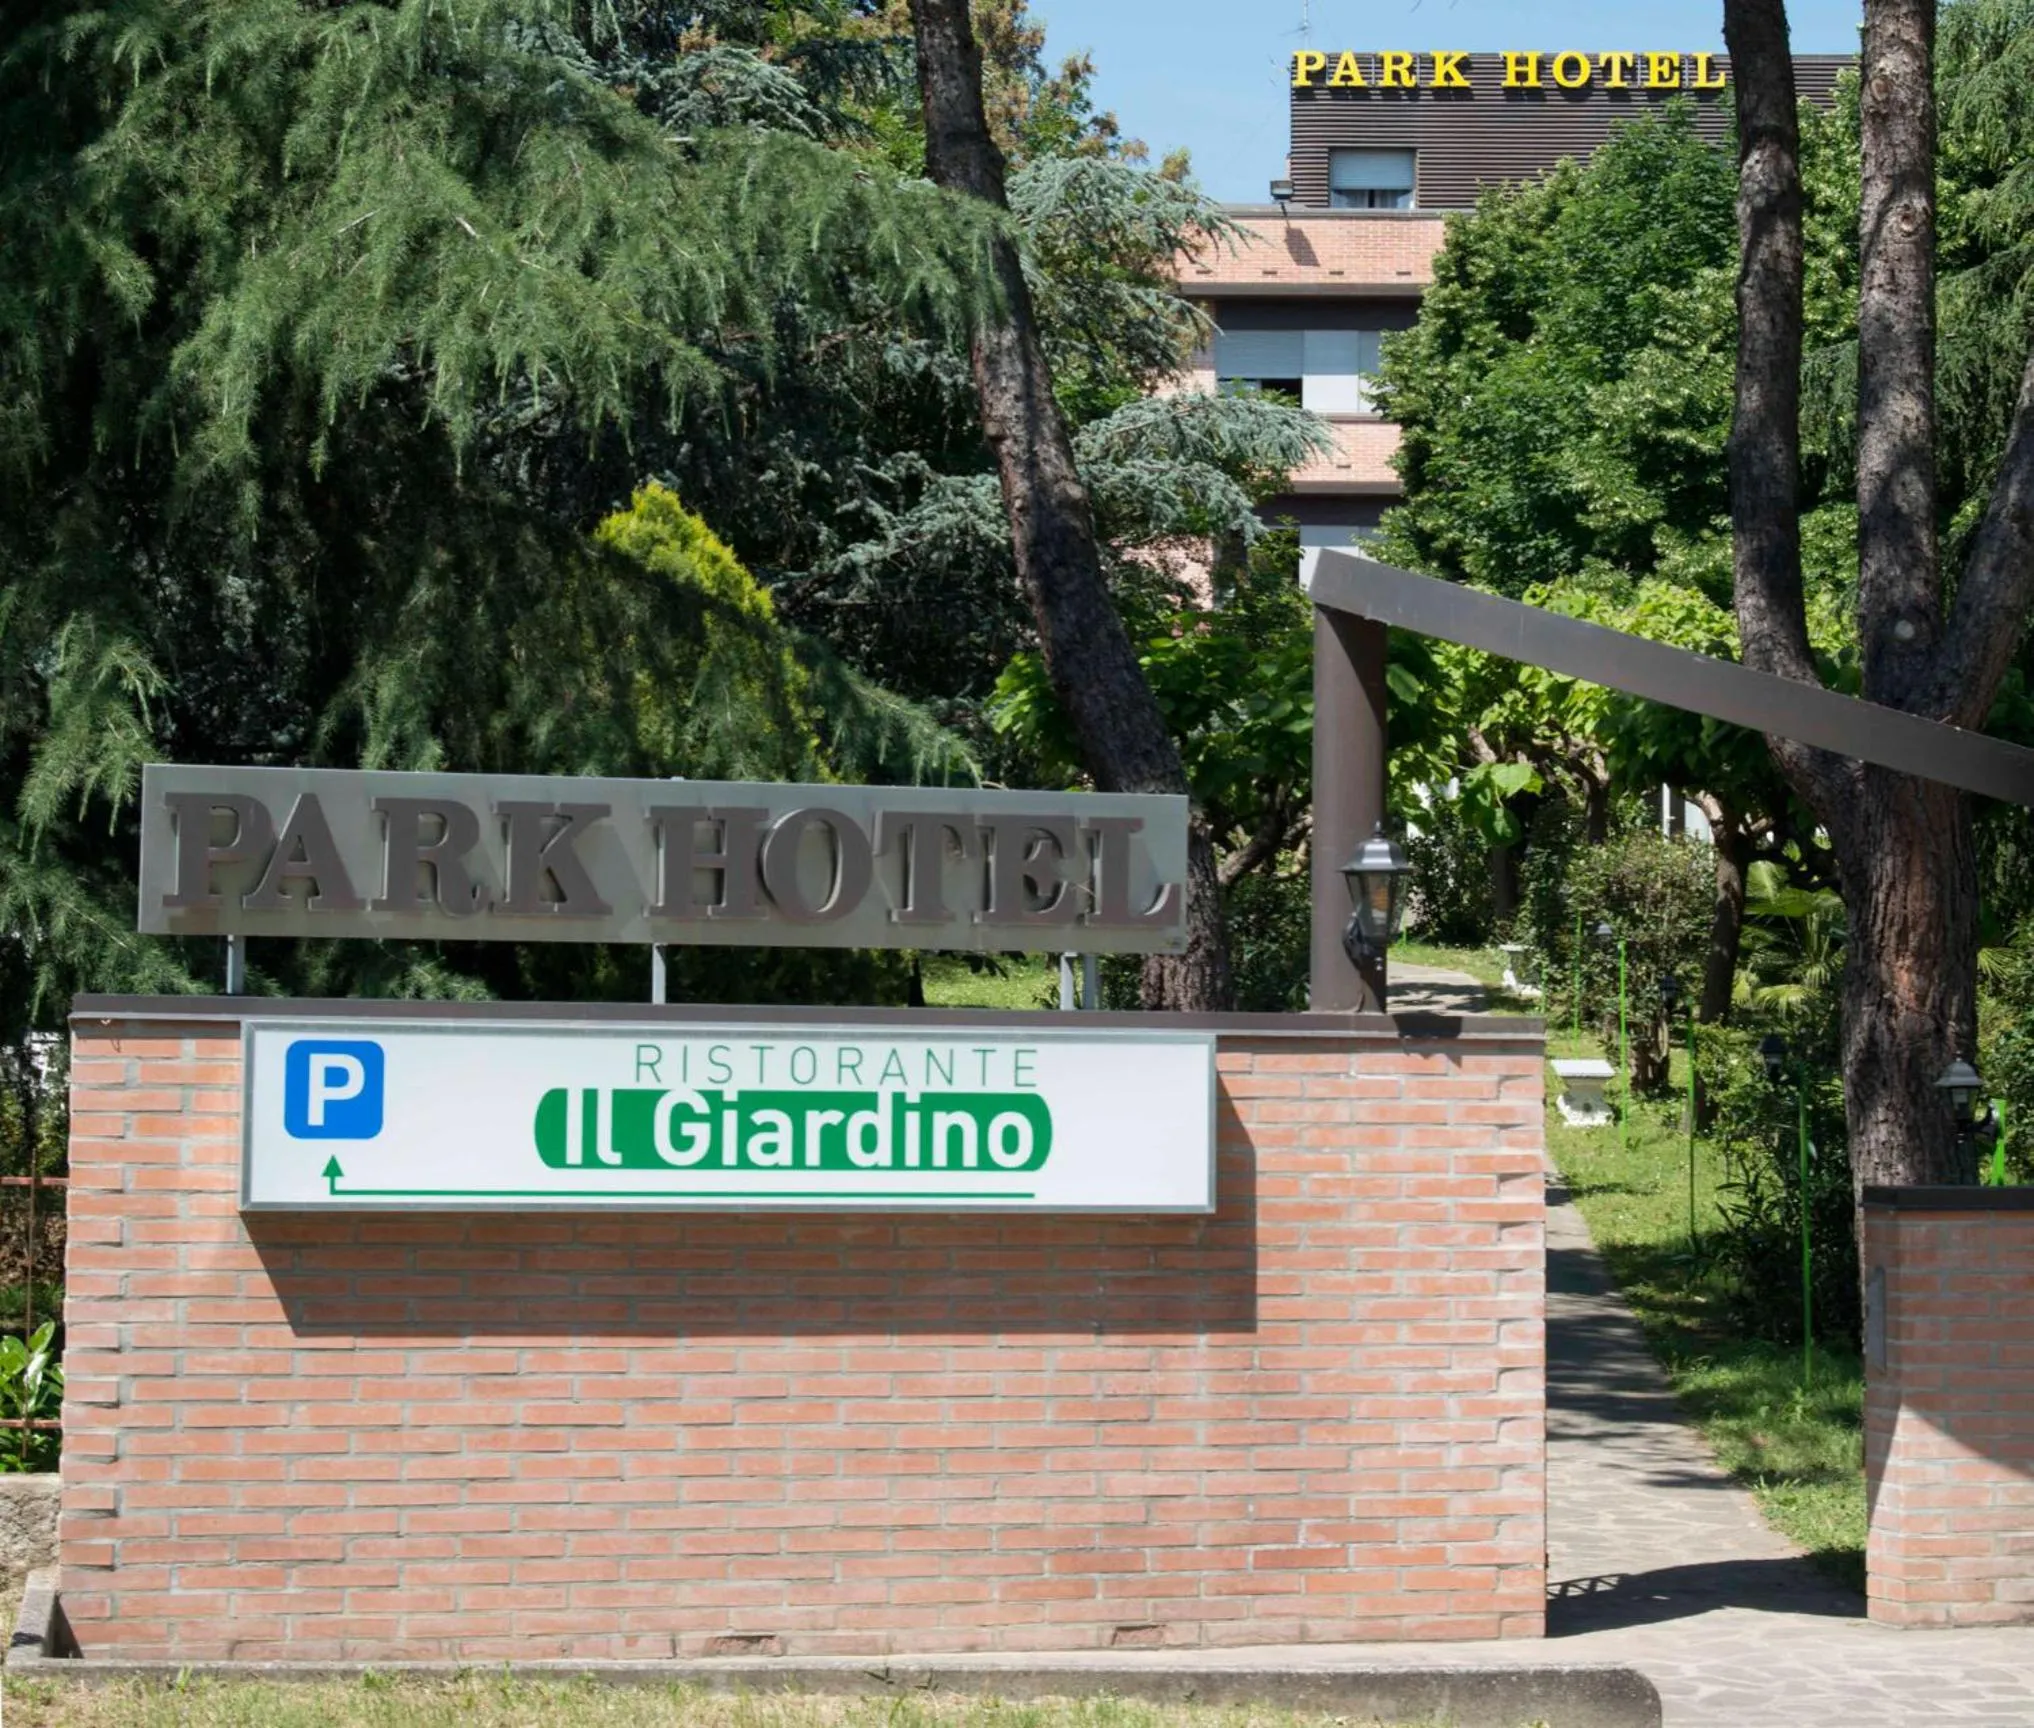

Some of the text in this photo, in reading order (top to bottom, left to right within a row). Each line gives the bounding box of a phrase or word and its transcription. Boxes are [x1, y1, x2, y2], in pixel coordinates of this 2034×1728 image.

[1292, 51, 1726, 88] PARK HOTEL
[162, 792, 1180, 928] PARK HOTEL
[307, 1053, 365, 1126] P
[635, 1044, 1038, 1088] RISTORANTE
[566, 1087, 1036, 1168] Il Giardino
